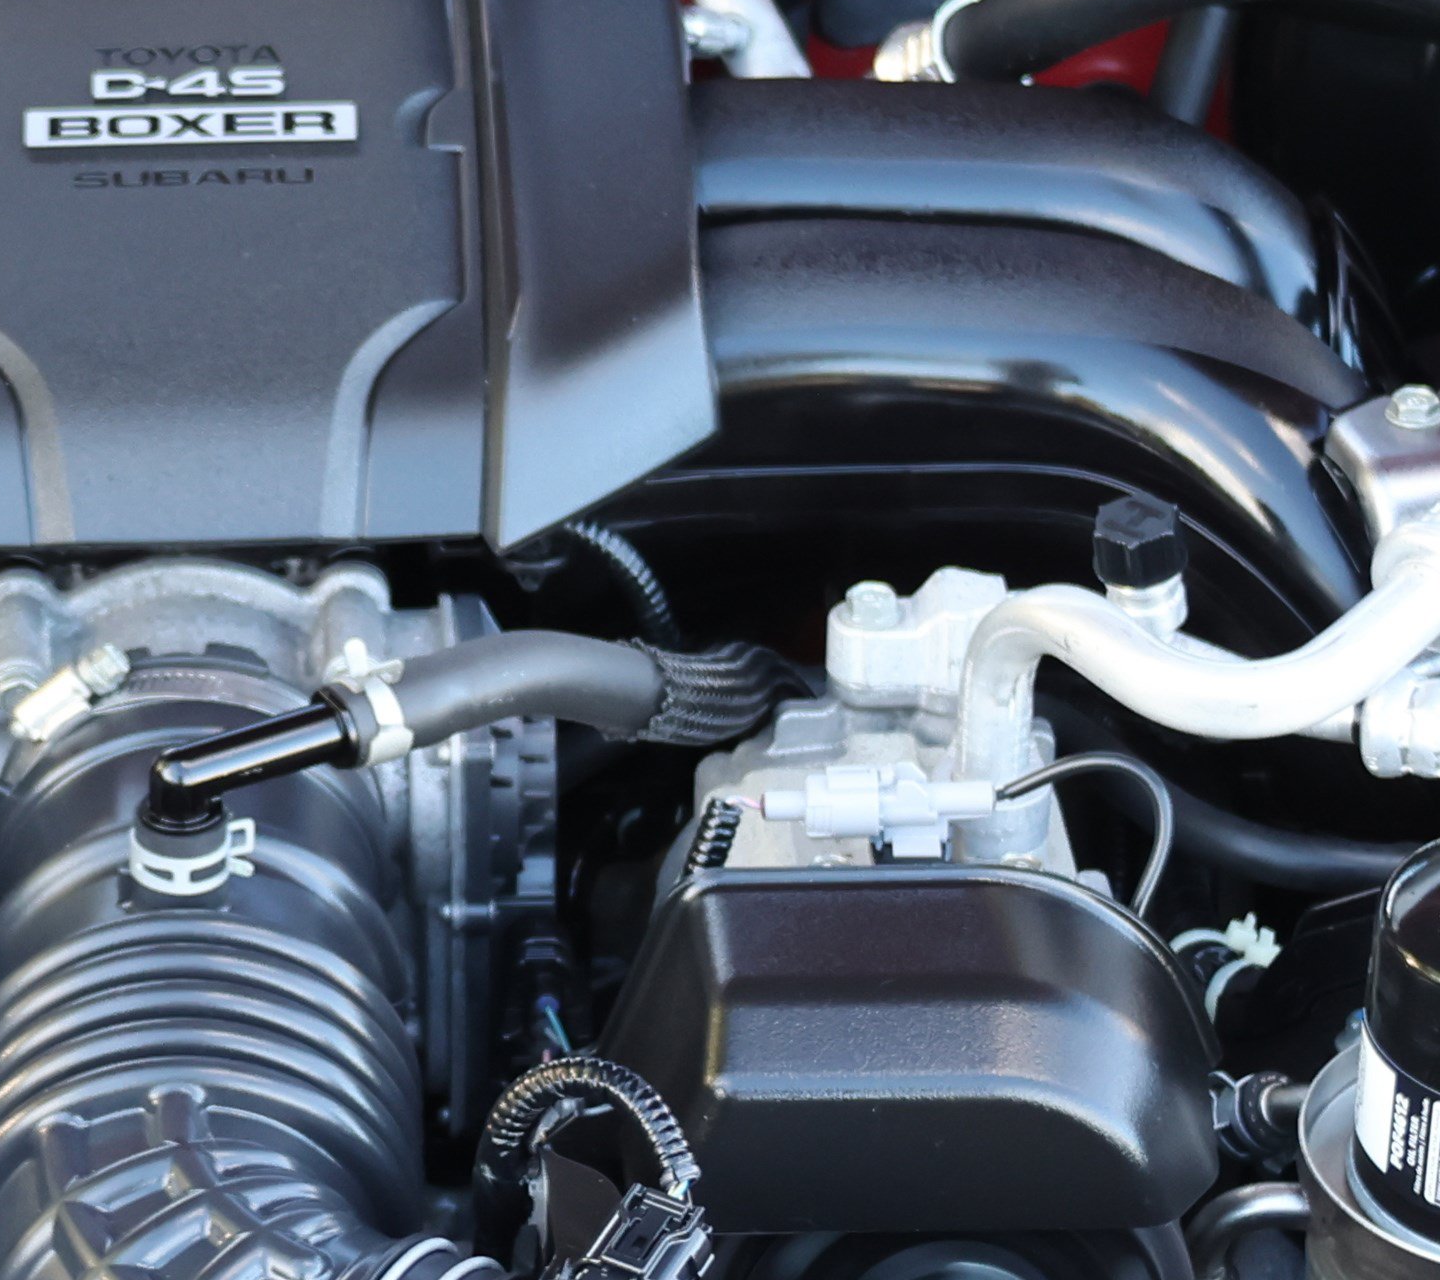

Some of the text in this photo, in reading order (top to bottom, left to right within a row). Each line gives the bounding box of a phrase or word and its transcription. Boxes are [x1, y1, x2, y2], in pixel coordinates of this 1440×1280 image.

[95, 44, 281, 66] TOYOTA
[90, 66, 286, 100] D-4S
[47, 111, 336, 140] BOXER
[73, 167, 315, 189] SUBARU
[1389, 1092, 1411, 1171] POF4612
